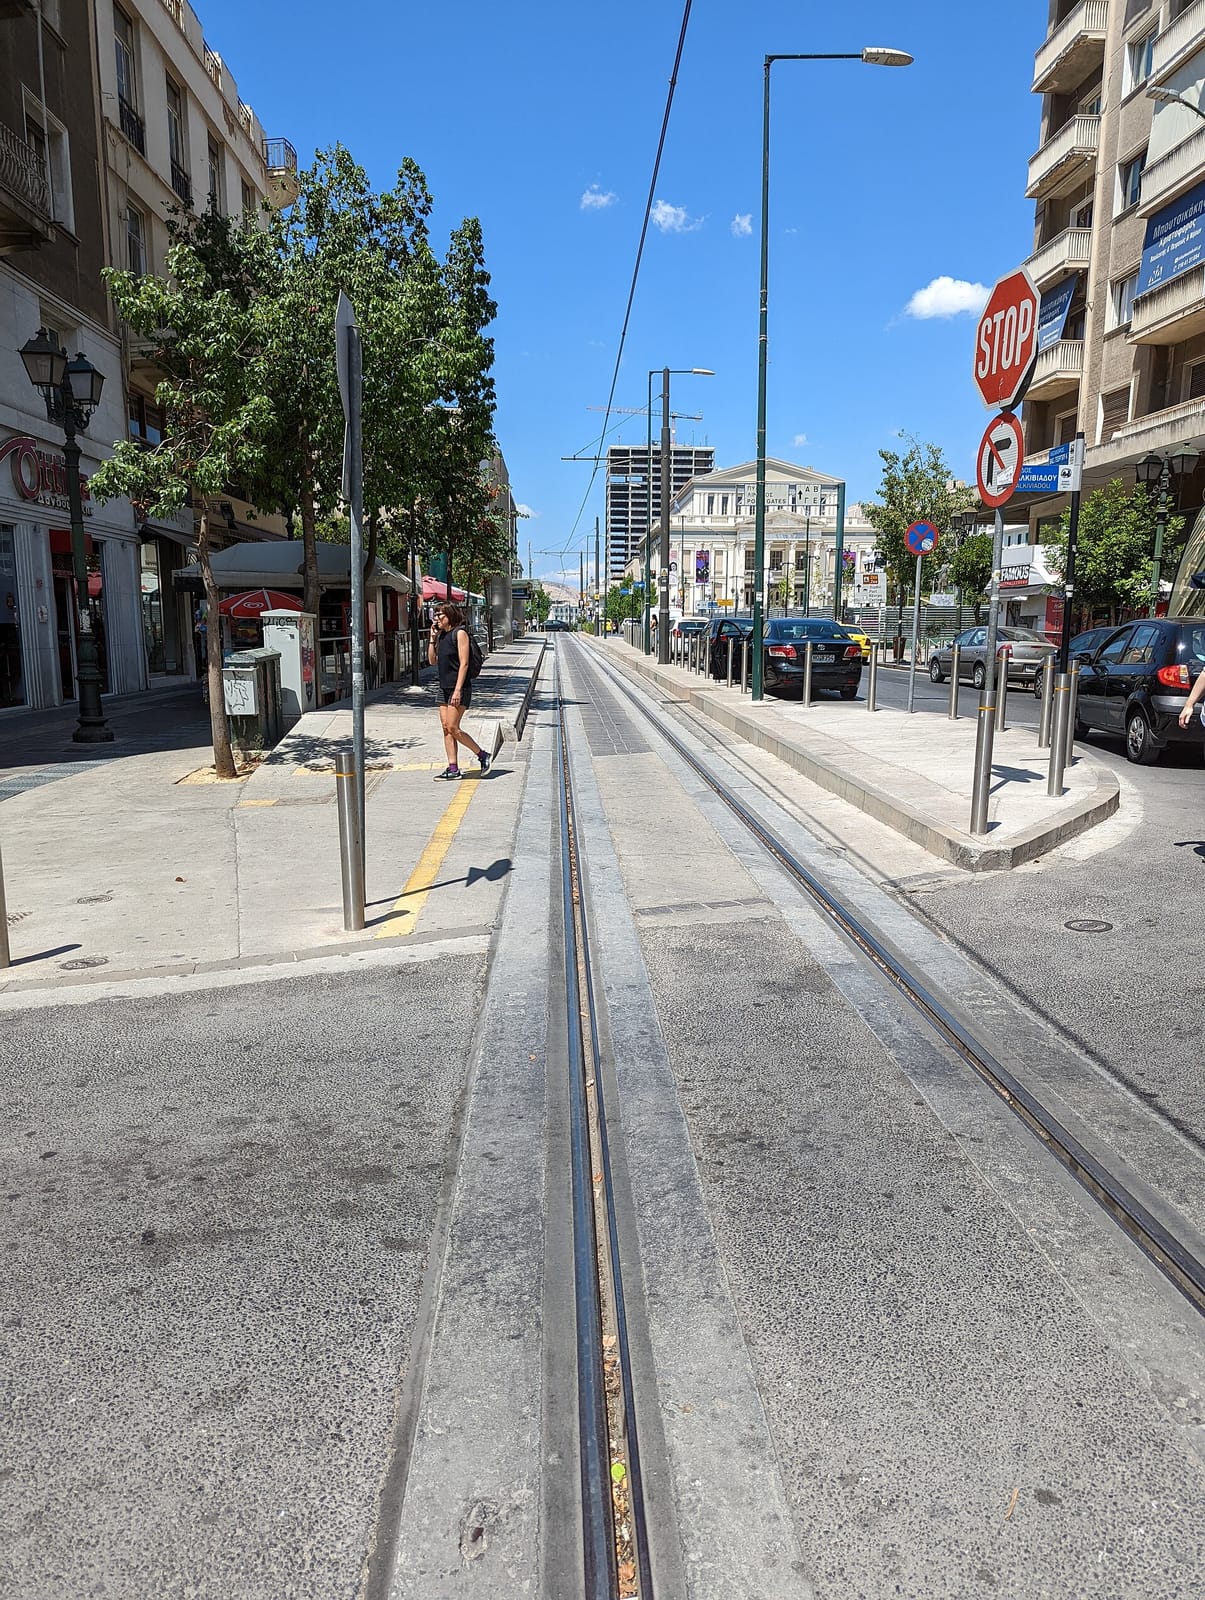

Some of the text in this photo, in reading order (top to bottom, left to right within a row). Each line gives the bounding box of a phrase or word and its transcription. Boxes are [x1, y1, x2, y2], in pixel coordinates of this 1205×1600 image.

[978, 299, 1032, 378] STOP
[1019, 474, 1058, 482] ΛΚΙΒΙΑΔΟΥ
[1001, 565, 1030, 581] FAMOUS
